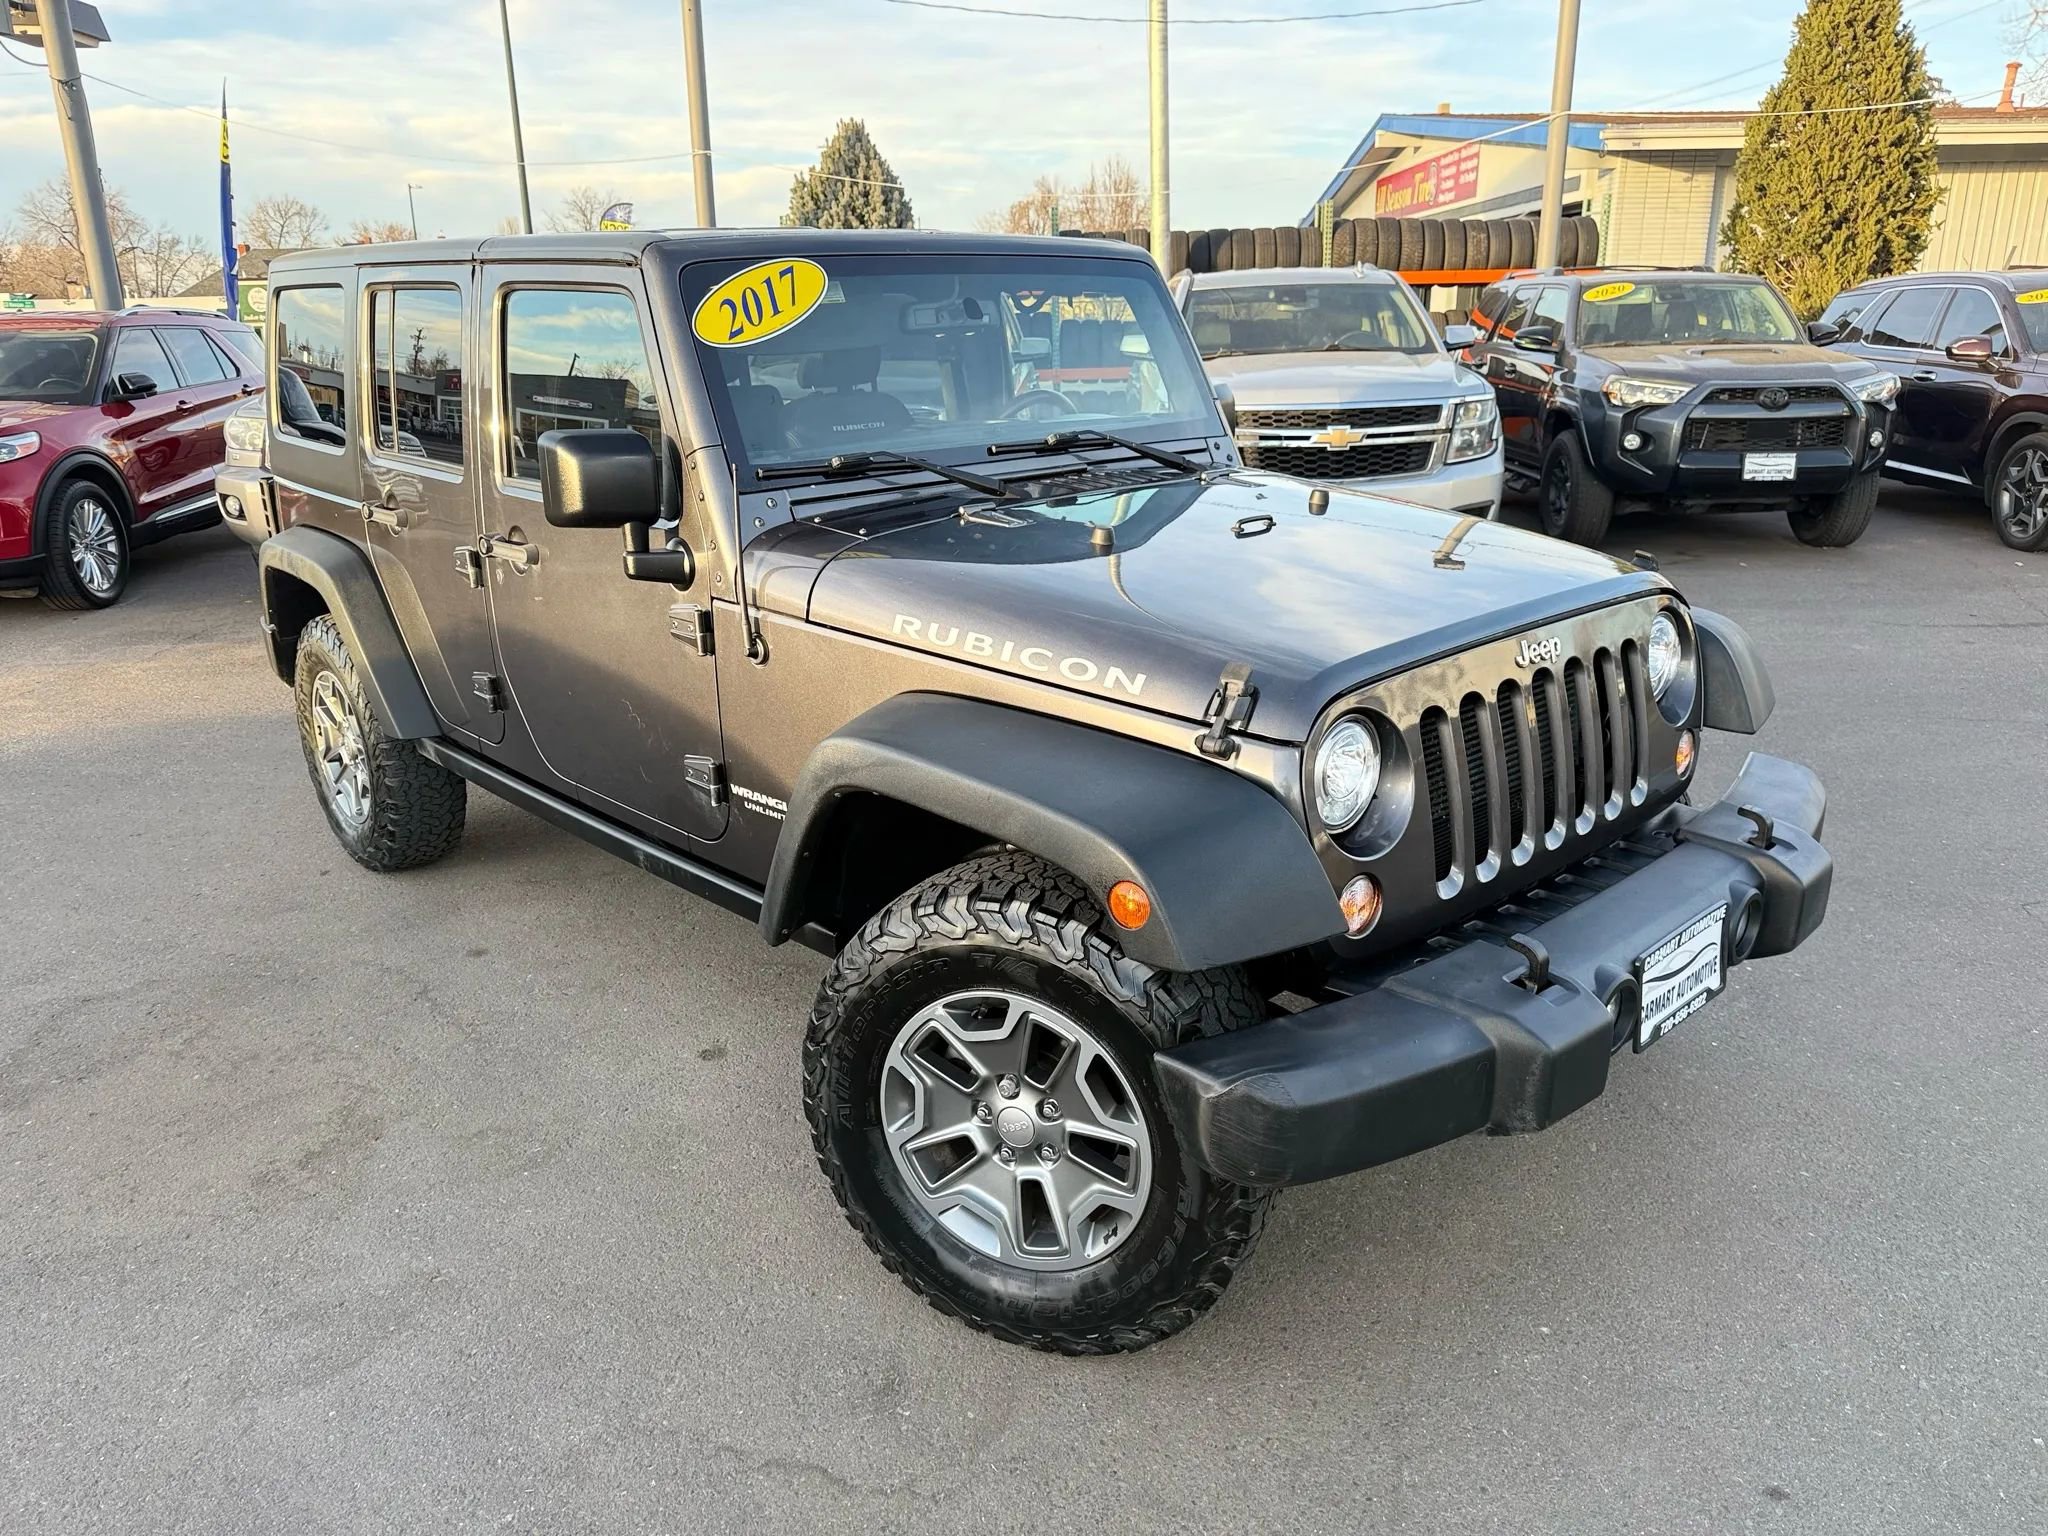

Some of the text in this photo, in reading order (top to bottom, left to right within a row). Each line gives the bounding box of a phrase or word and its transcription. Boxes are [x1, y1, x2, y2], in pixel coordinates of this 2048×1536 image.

[1386, 184, 1412, 212] Season
[719, 265, 796, 340] 2017
[1594, 285, 1625, 299] 2020
[832, 421, 885, 431] RUBICON
[892, 614, 1147, 696] RUBICON
[1515, 636, 1561, 668] Jeep
[1644, 905, 1728, 971] CARMART AUTOMOTIVE
[1676, 955, 1718, 1002] AUTOMOTIVE
[1002, 1120, 1029, 1133] Jeep
